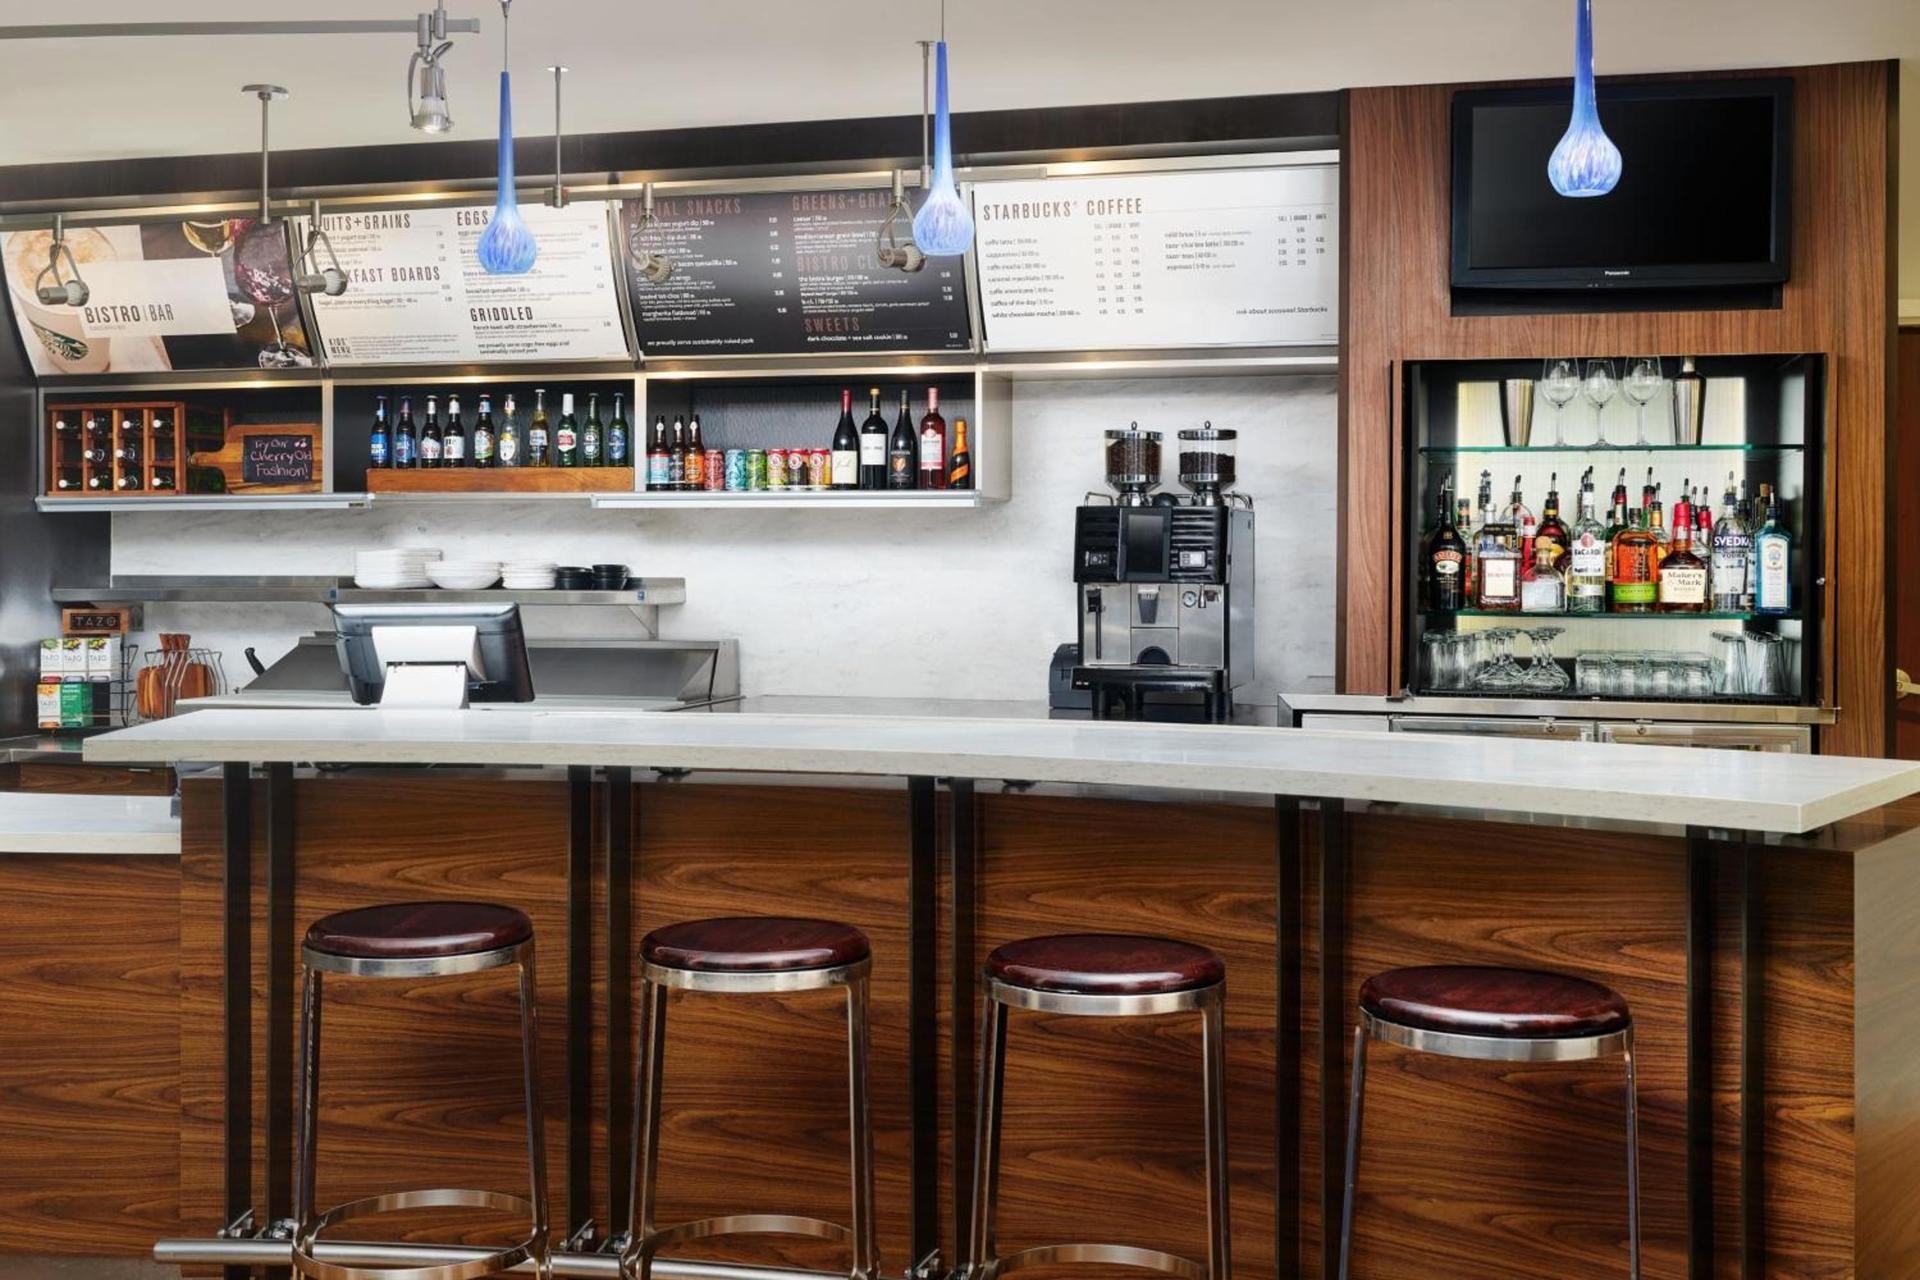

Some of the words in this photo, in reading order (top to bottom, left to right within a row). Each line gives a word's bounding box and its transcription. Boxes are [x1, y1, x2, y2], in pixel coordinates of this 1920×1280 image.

[687, 198, 741, 215] SNACKS
[1087, 198, 1142, 216] COFFEE
[457, 211, 489, 226] EGGS
[799, 255, 848, 273] BISTRO
[391, 266, 440, 283] BOARDS
[85, 304, 140, 323] BISTRO
[149, 303, 175, 322] BAR
[470, 306, 533, 322] GRIDDLED
[805, 317, 860, 333] SWEETS
[270, 438, 288, 448] Our
[250, 450, 294, 465] Cherry
[255, 463, 309, 480] Fashion!
[74, 616, 117, 627] TAZO
